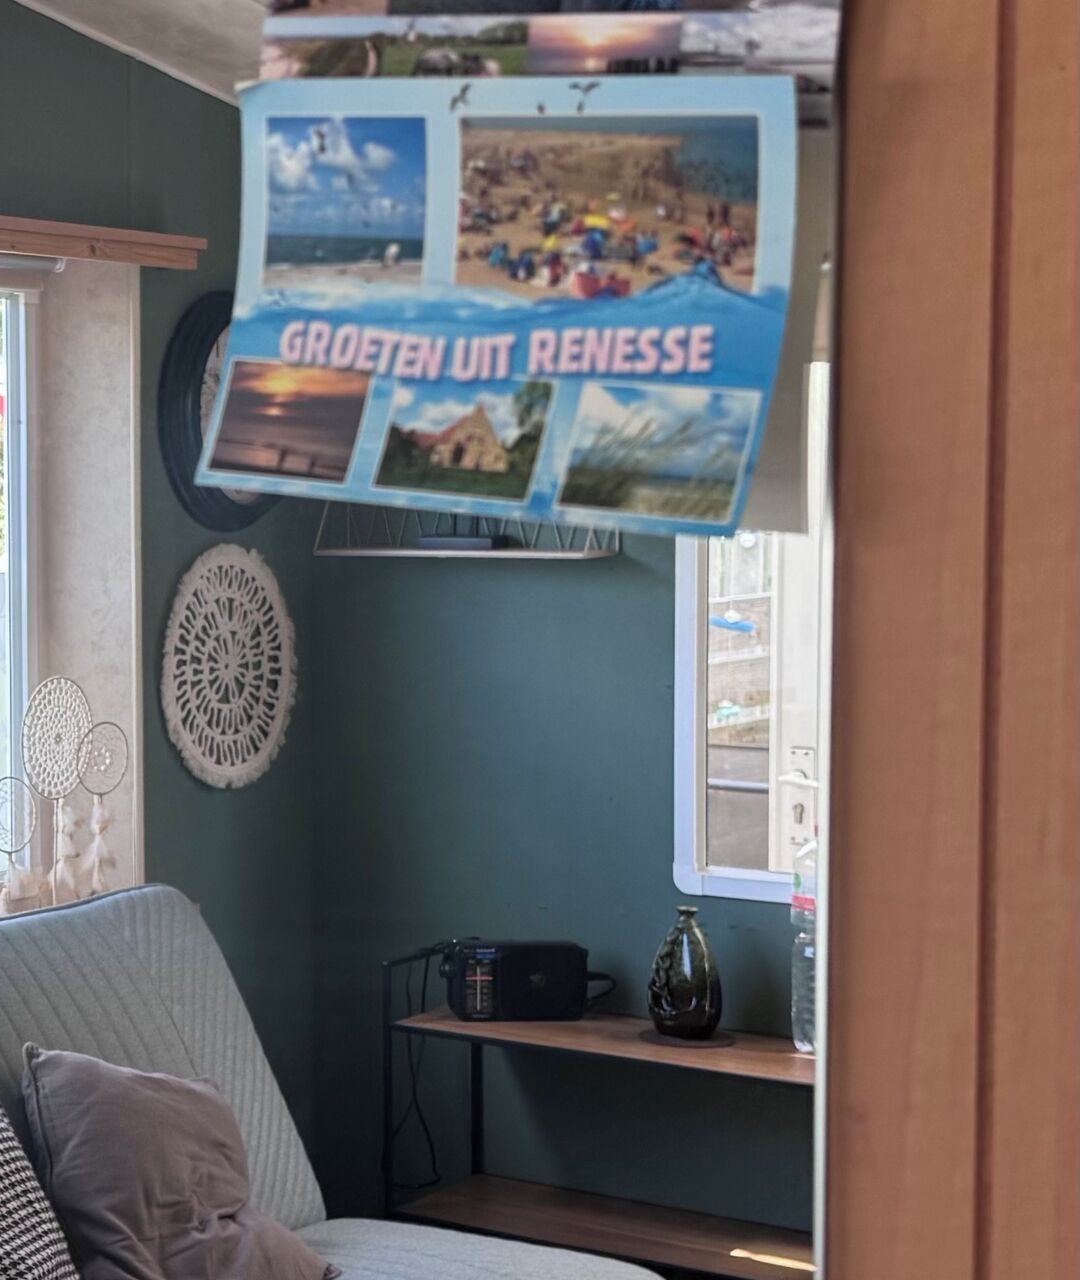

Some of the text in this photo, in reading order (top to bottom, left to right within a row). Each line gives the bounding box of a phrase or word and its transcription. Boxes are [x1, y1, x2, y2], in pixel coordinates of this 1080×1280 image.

[279, 320, 715, 382] GROETEN UIT RENESSE
